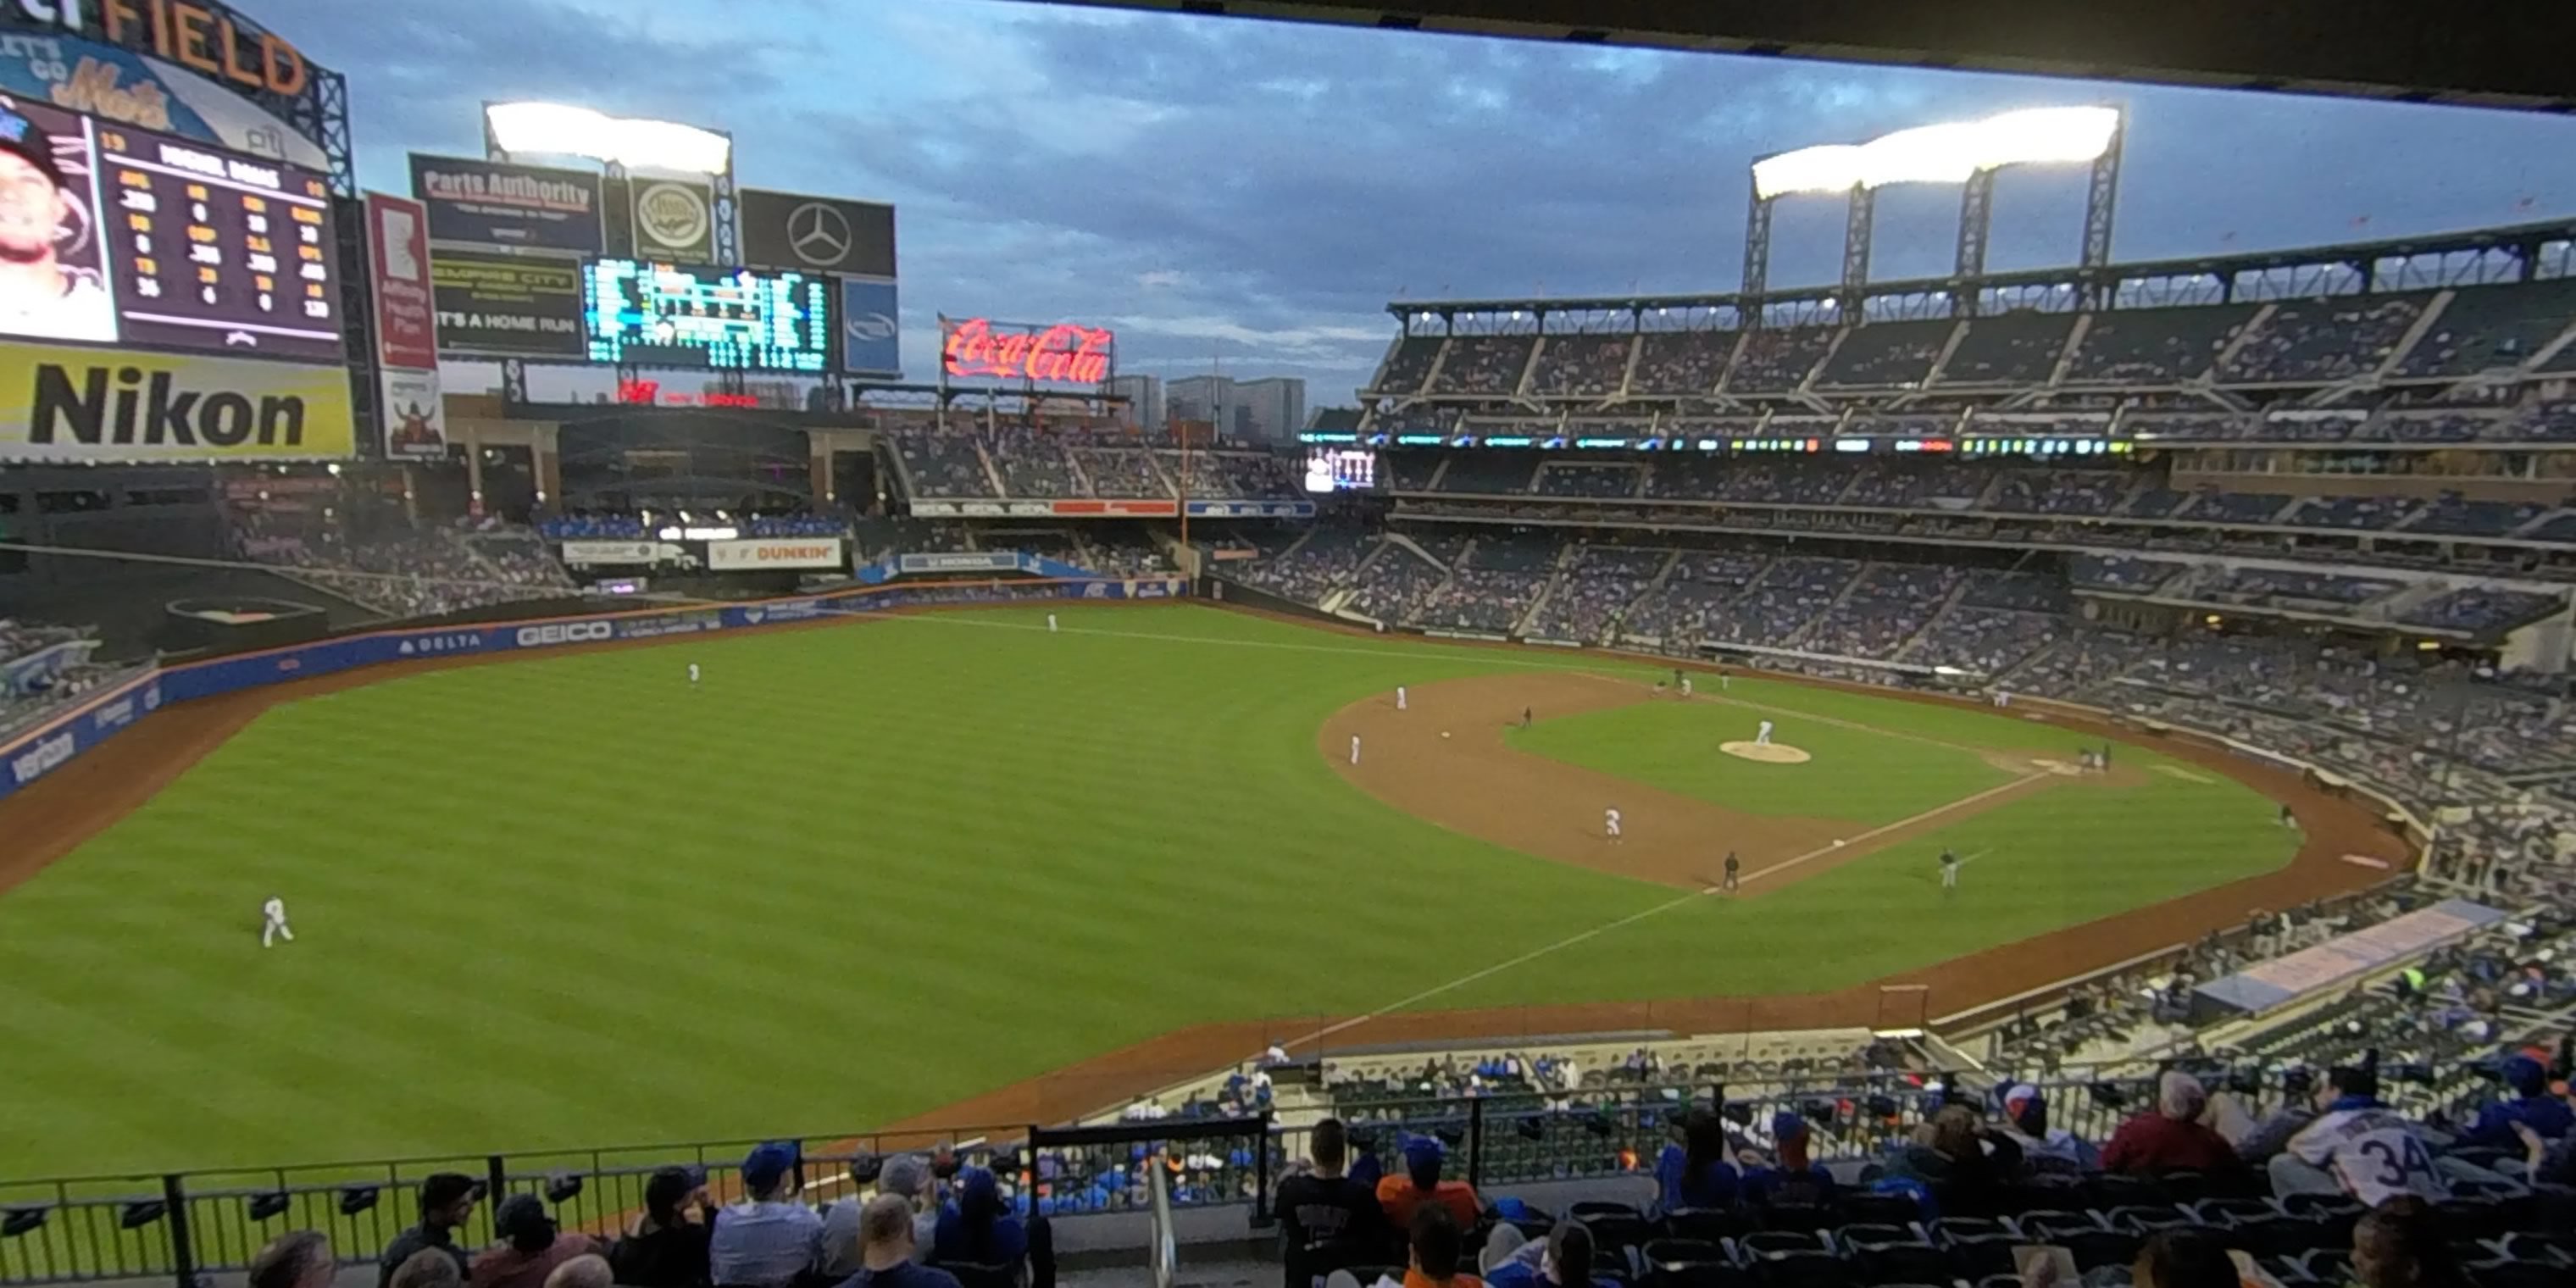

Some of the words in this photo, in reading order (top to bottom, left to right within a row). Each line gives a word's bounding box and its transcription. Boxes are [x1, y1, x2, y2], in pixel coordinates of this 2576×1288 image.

[0, 36, 62, 60] ET'S
[103, 0, 305, 96] FIELD
[31, 58, 69, 83] GO
[51, 55, 175, 130] Mets
[425, 170, 486, 196] Parts
[488, 173, 591, 205] Authority
[469, 314, 483, 329] A
[484, 314, 537, 331] HOME
[540, 318, 577, 333] RUN
[946, 317, 1112, 384] Coca-Cola
[29, 363, 305, 447] Nikon
[418, 634, 482, 652] DELTA
[516, 620, 613, 647] GEICO
[2359, 1135, 2437, 1188] 34
